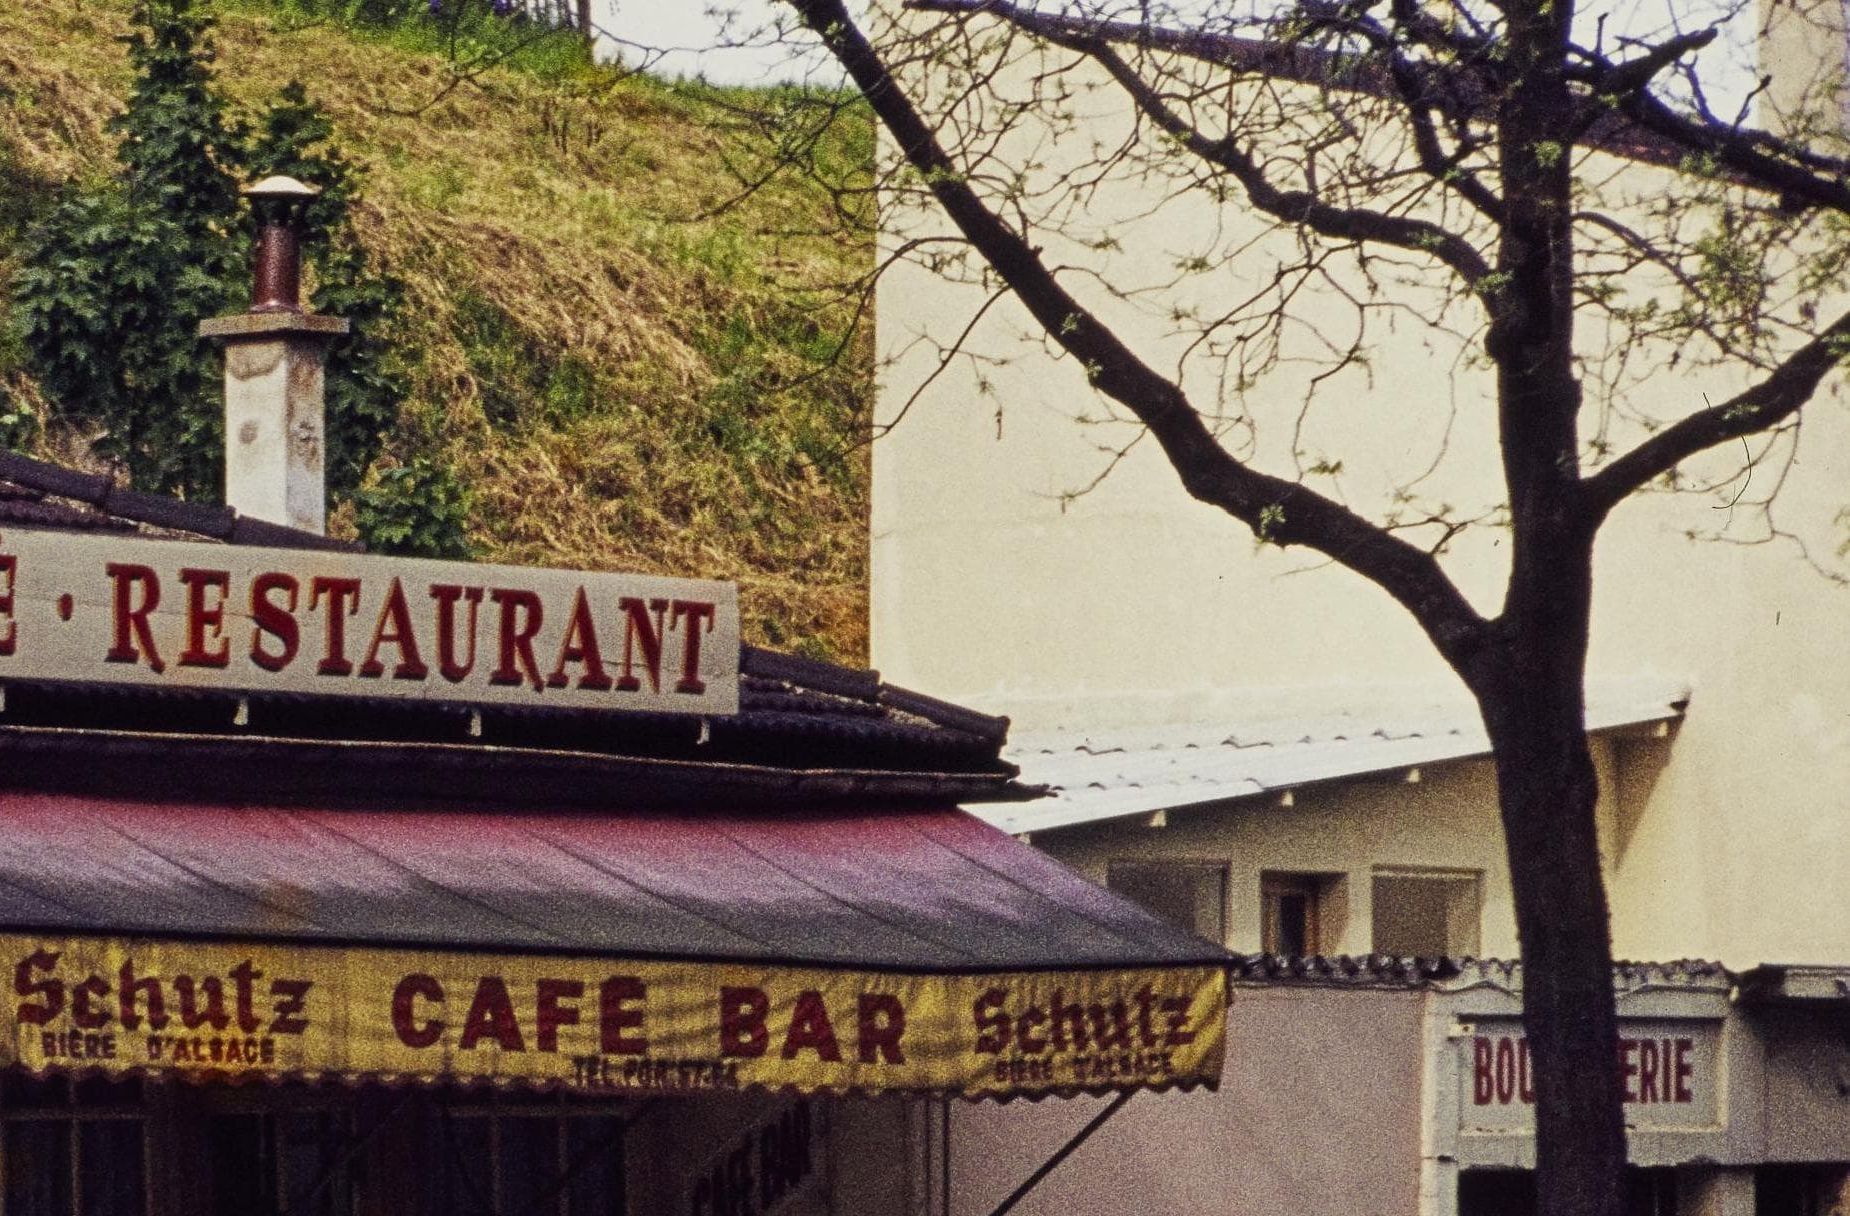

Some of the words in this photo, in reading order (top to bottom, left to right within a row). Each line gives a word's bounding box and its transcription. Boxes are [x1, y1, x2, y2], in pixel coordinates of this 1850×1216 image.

[105, 561, 716, 695] RESTAURANT
[15, 949, 313, 1035] Schutz
[391, 972, 648, 1055] CAFE
[719, 983, 907, 1065] BAR
[974, 984, 1197, 1054] Schutz
[147, 1035, 275, 1064] D'ALSACE
[760, 1100, 811, 1210] BAR
